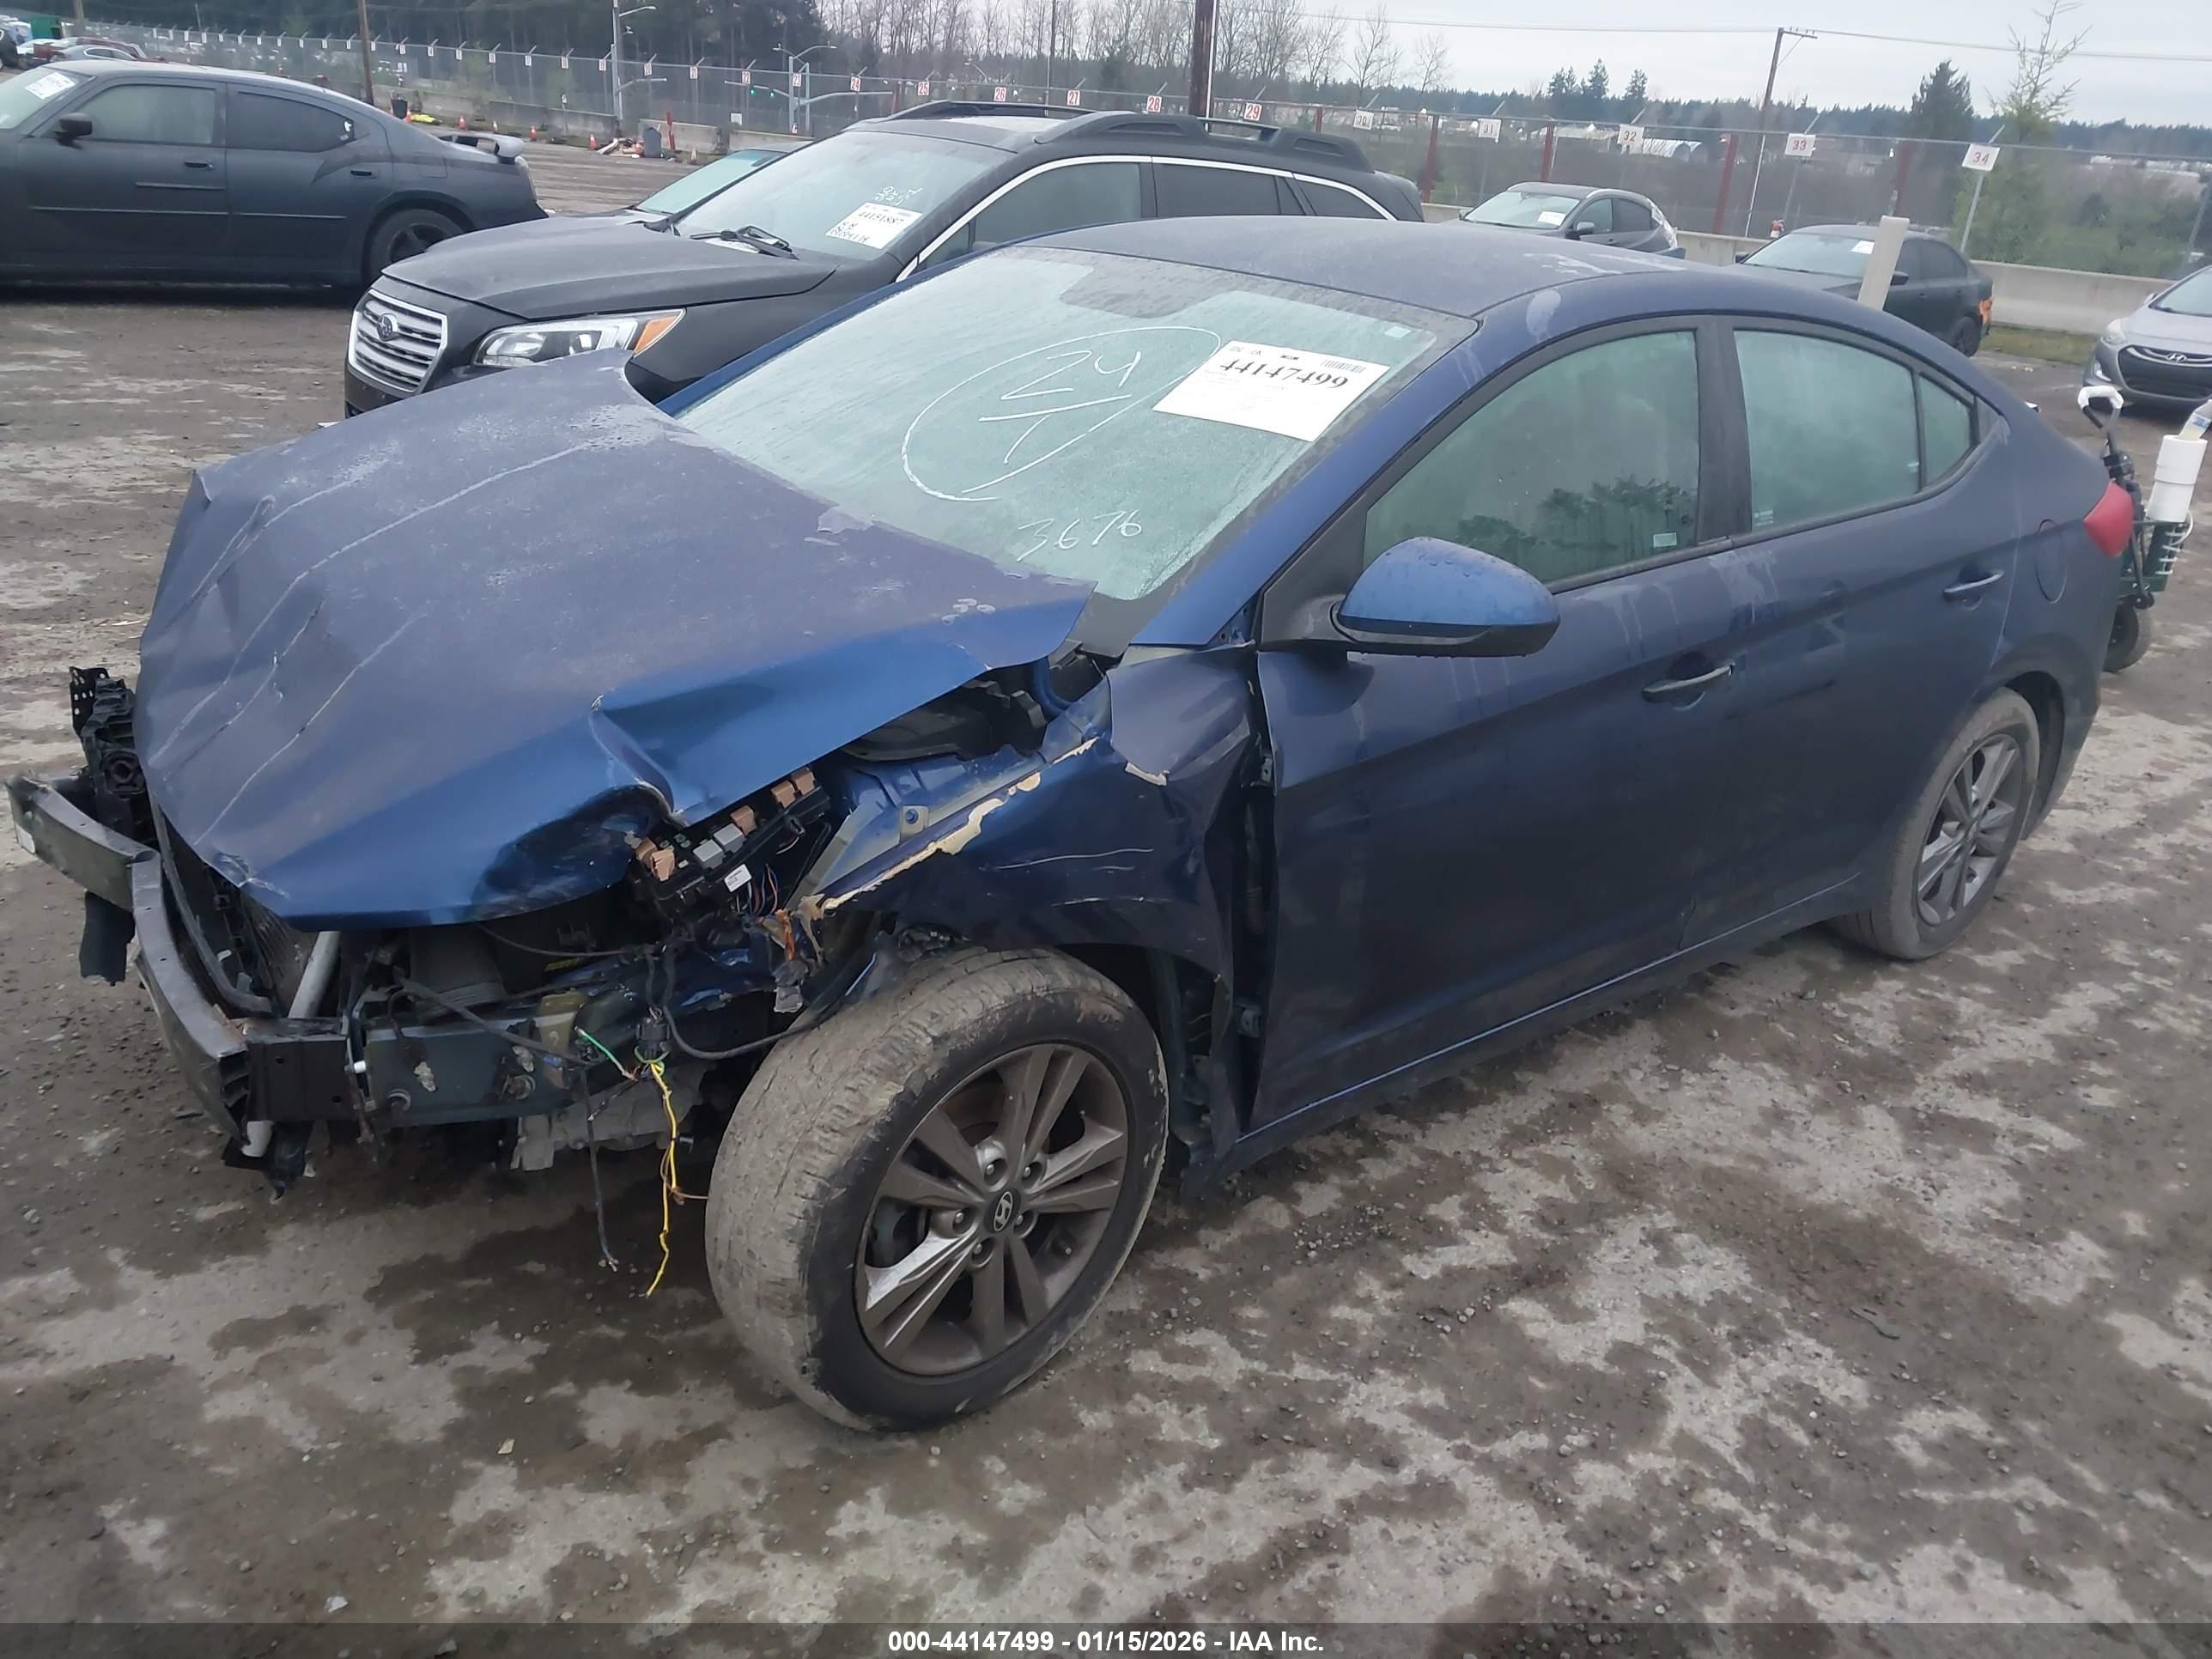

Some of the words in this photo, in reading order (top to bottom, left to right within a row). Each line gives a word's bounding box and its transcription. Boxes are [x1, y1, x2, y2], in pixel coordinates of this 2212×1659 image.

[742, 71, 750, 83] 22
[793, 74, 800, 85] 23
[852, 78, 860, 90] 24
[919, 82, 928, 95] 25
[995, 88, 1005, 101] 26
[1068, 90, 1079, 105] 27
[1148, 96, 1160, 112] 28
[1246, 104, 1260, 120] 29
[1358, 115, 1367, 125] 30
[1483, 124, 1493, 134] 31
[1623, 130, 1637, 142] 32
[1792, 139, 1807, 151] 33
[1972, 151, 1990, 166] 34
[1220, 359, 1348, 388] 44147499
[1017, 509, 1142, 562] 3676
